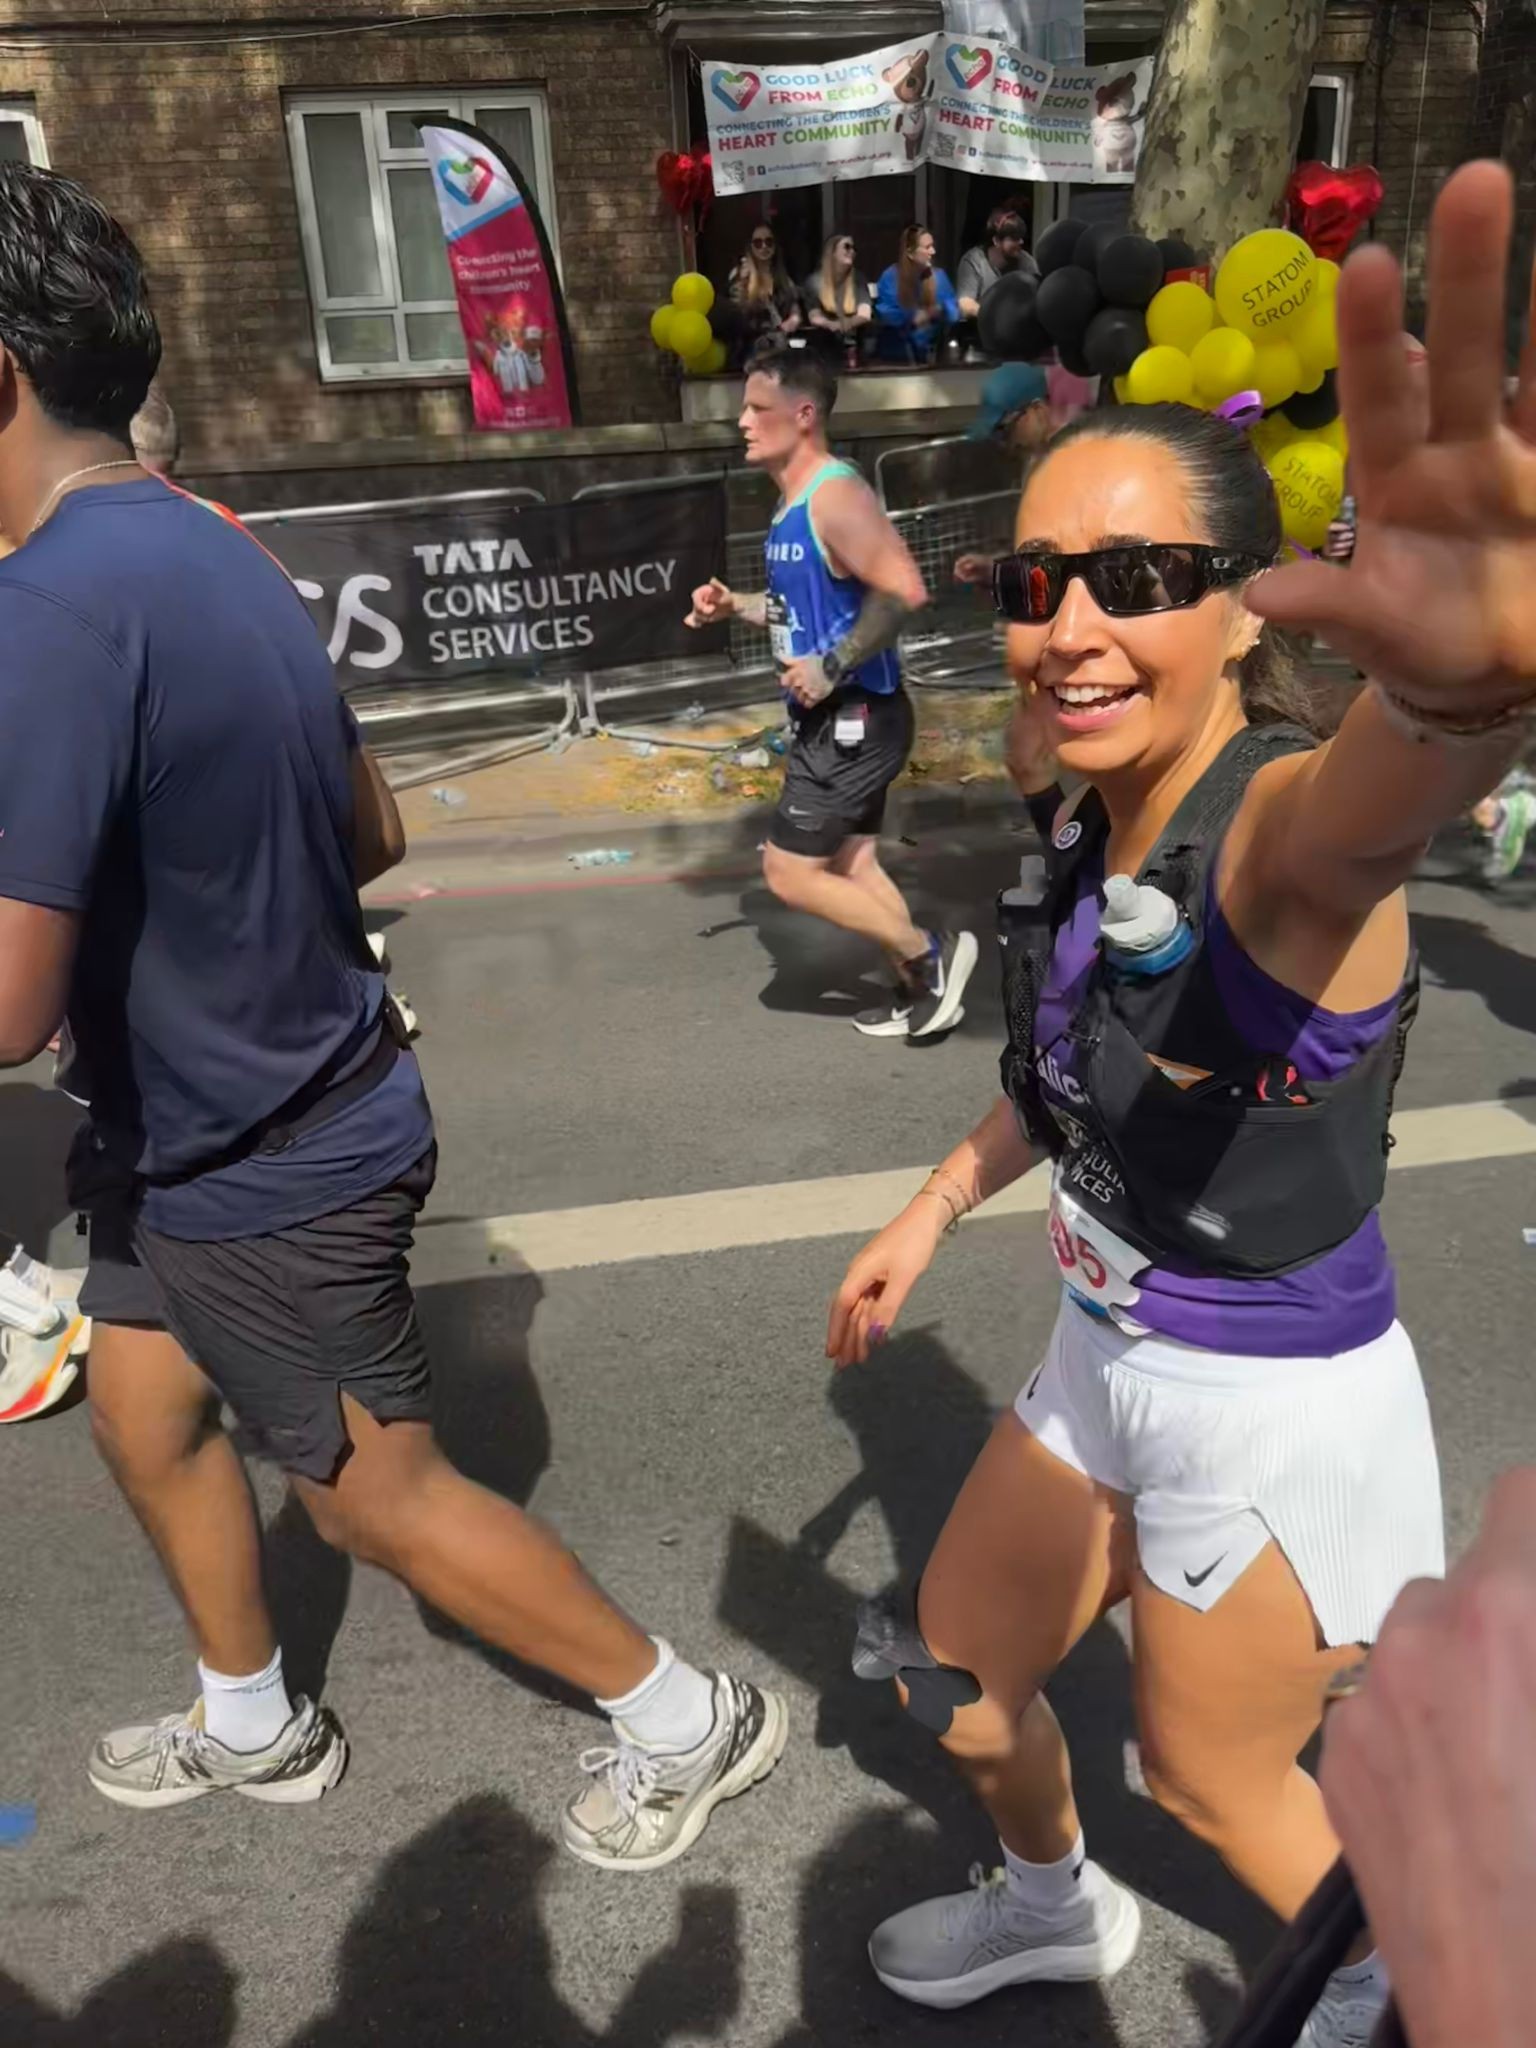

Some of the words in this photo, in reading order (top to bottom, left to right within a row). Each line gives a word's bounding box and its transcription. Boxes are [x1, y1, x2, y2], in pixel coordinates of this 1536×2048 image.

[765, 73, 820, 86] GOOD
[825, 64, 874, 84] LUCK
[997, 55, 1048, 84] GOOD
[1049, 77, 1097, 91] LUCK
[767, 90, 823, 105] FROM
[826, 83, 878, 101] ECHO
[992, 77, 1040, 103] FROM
[1041, 93, 1090, 110] ECHO
[716, 117, 793, 134] CONNECTING
[797, 114, 819, 126] THE
[718, 132, 777, 152] HEART
[782, 118, 891, 145] COMMUNITY
[939, 108, 995, 132] HEART
[998, 120, 1092, 145] COMMUNITY
[1242, 250, 1310, 310] STATOM
[1252, 279, 1312, 327] GROUP
[413, 539, 532, 575] TATA
[422, 559, 677, 619] CONSULTANCY
[428, 615, 594, 663] SERVICES
